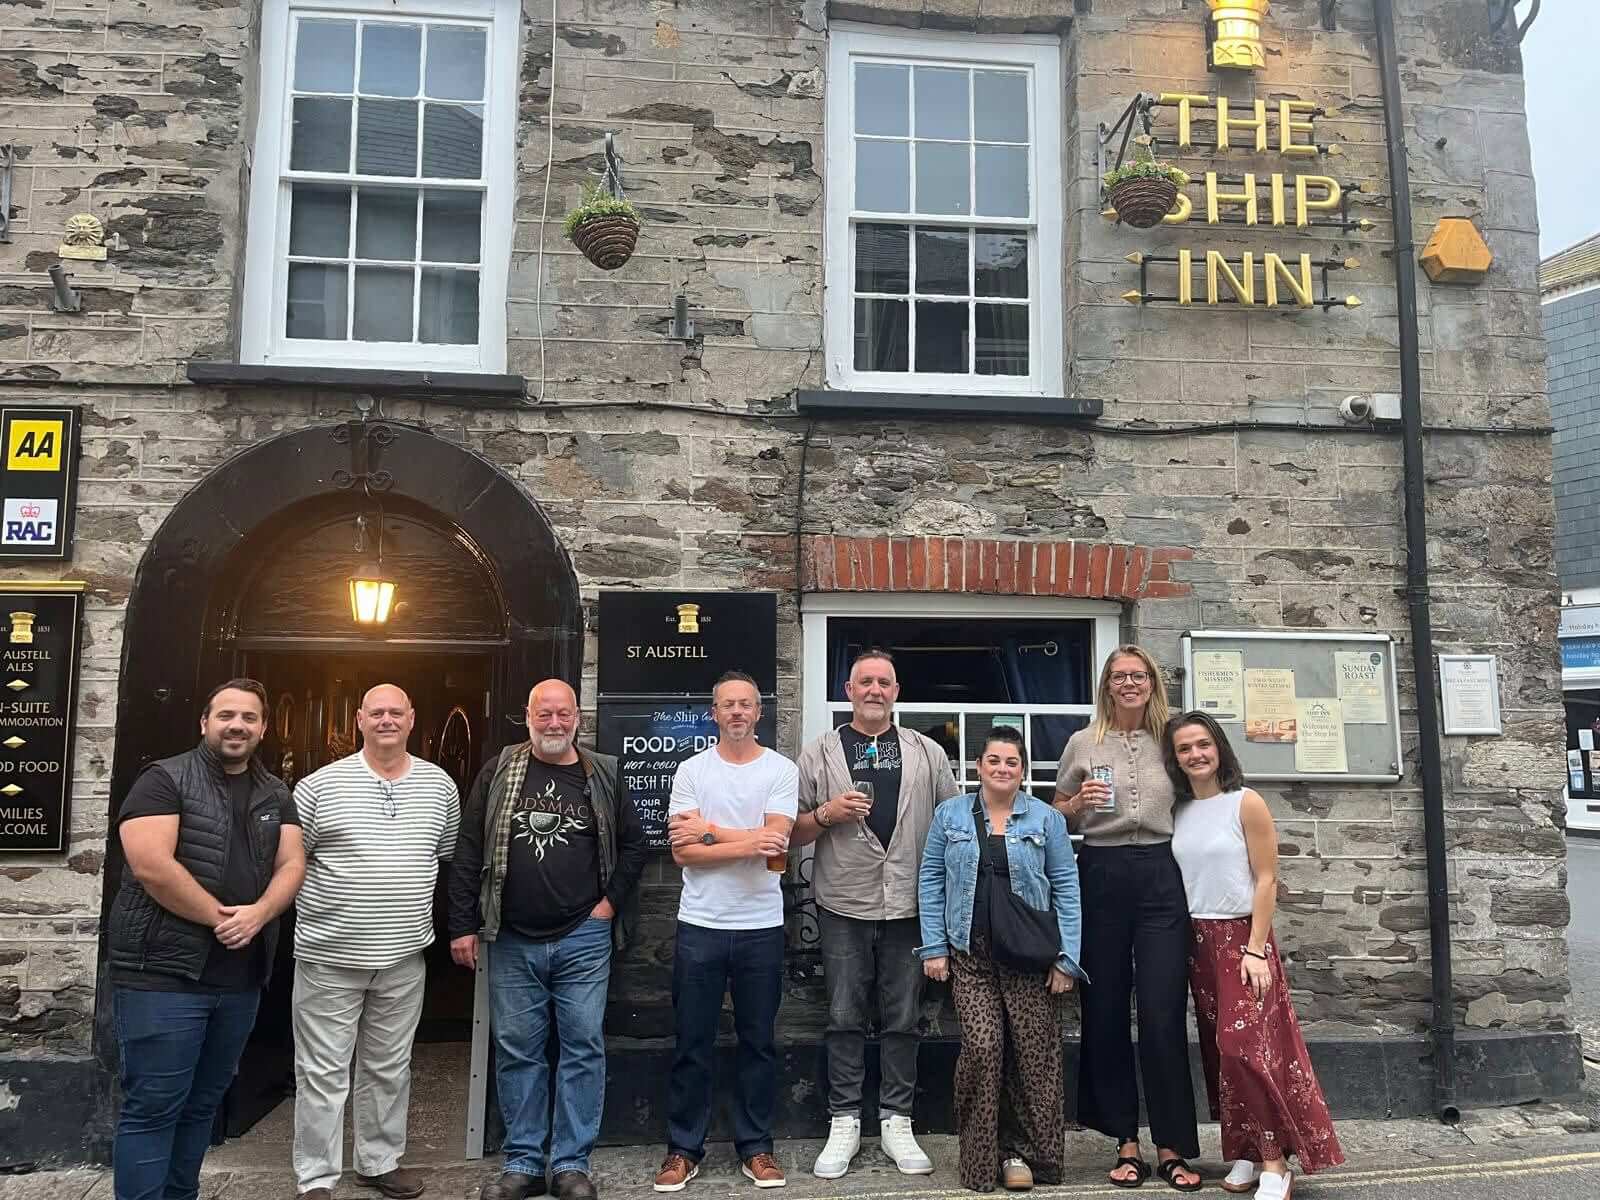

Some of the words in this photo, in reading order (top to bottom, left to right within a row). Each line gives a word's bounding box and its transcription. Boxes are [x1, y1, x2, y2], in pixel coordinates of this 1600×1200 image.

[1161, 93, 1318, 154] THE
[1179, 250, 1314, 308] INN
[15, 431, 54, 458] AA
[6, 521, 52, 541] RAC
[3, 651, 51, 660] AUSTELL
[627, 646, 641, 658] ST
[645, 646, 708, 658] AUSTELL
[6, 663, 34, 672] ALES
[1342, 664, 1377, 672] SUNDAY
[1344, 672, 1375, 680] ROAST
[653, 711, 672, 721] The
[672, 711, 698, 724] Ship
[623, 736, 676, 754] FOOD
[19, 761, 59, 773] FOOD
[623, 760, 646, 770] HOT
[652, 760, 677, 769] COLD
